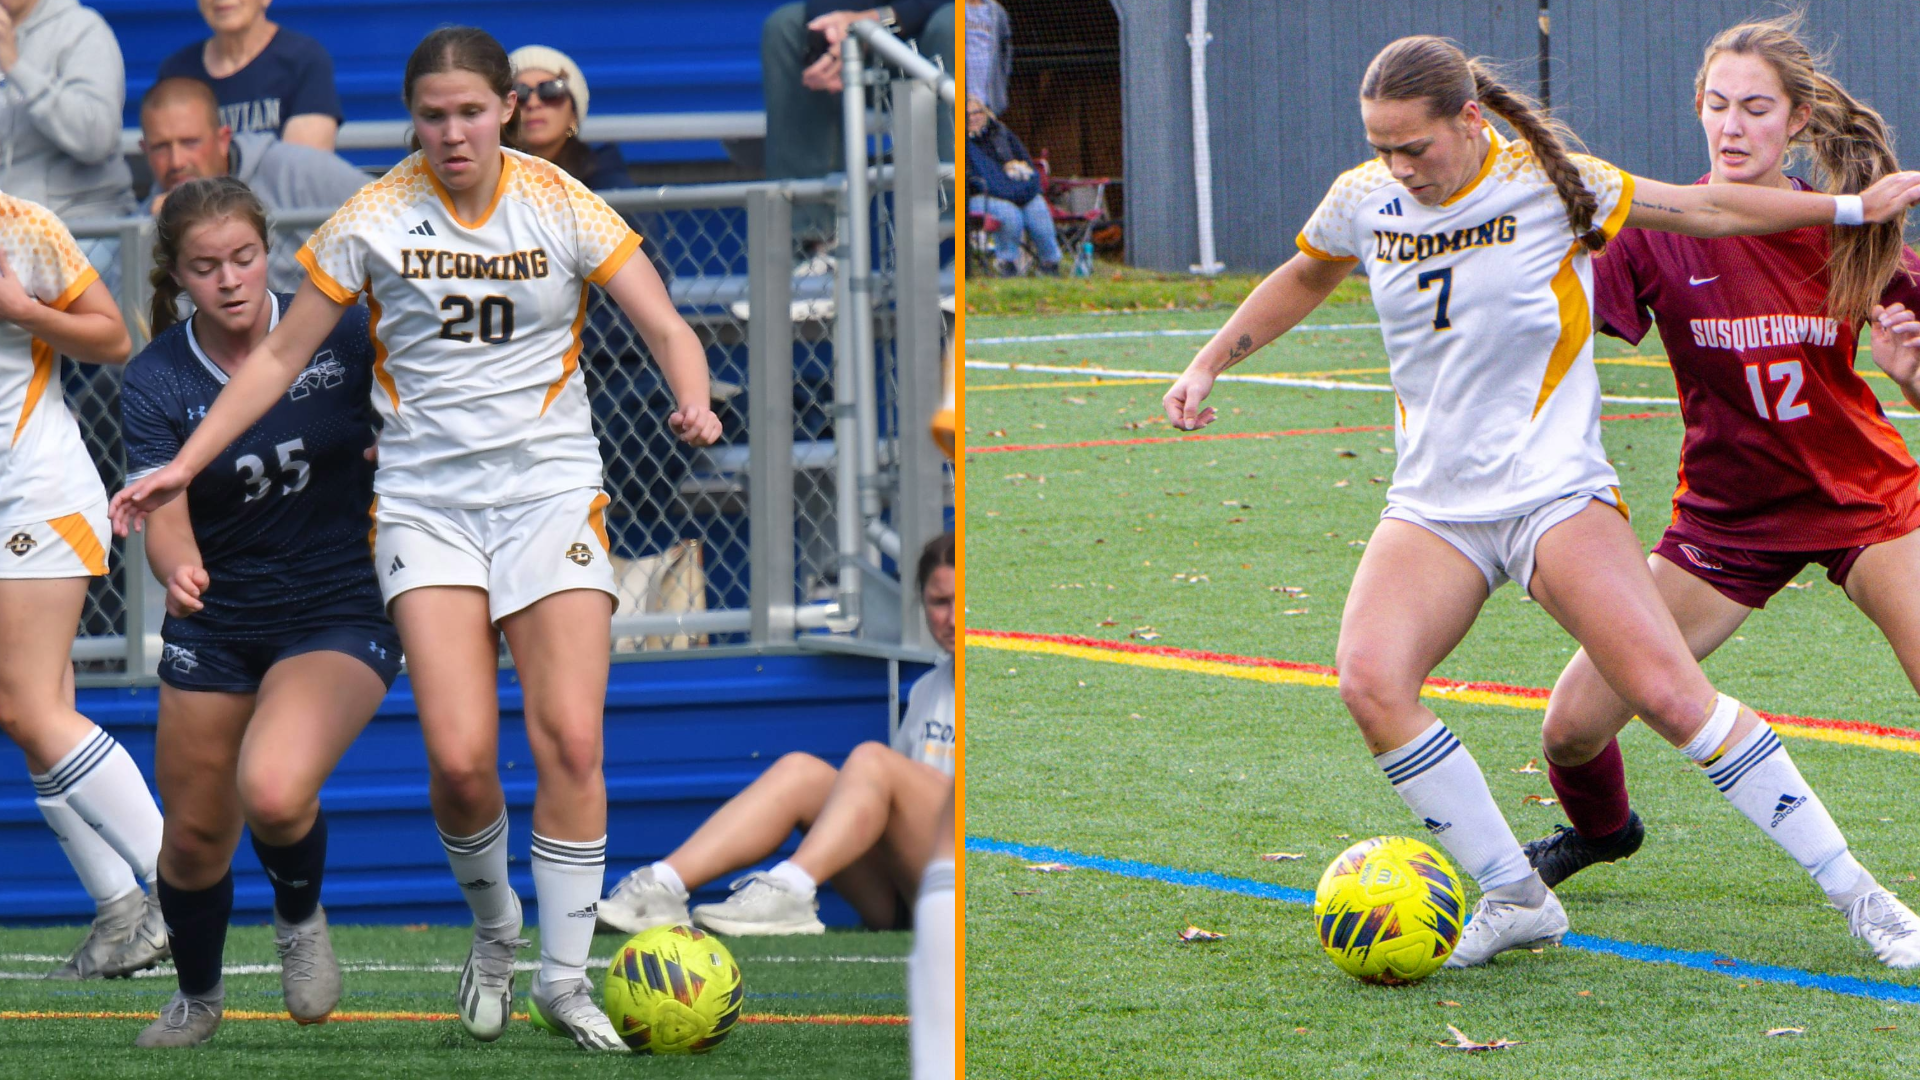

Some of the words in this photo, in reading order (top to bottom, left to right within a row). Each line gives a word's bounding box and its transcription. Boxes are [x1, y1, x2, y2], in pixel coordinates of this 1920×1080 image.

[1372, 215, 1517, 263] LYCOMING
[401, 248, 549, 281] LYCOMING
[439, 294, 515, 345] 20
[1417, 267, 1453, 332] 7
[1689, 314, 1839, 352] SUSQUEHANNA
[1744, 359, 1811, 422] 12
[236, 438, 310, 503] 35
[1770, 795, 1807, 828] adidas
